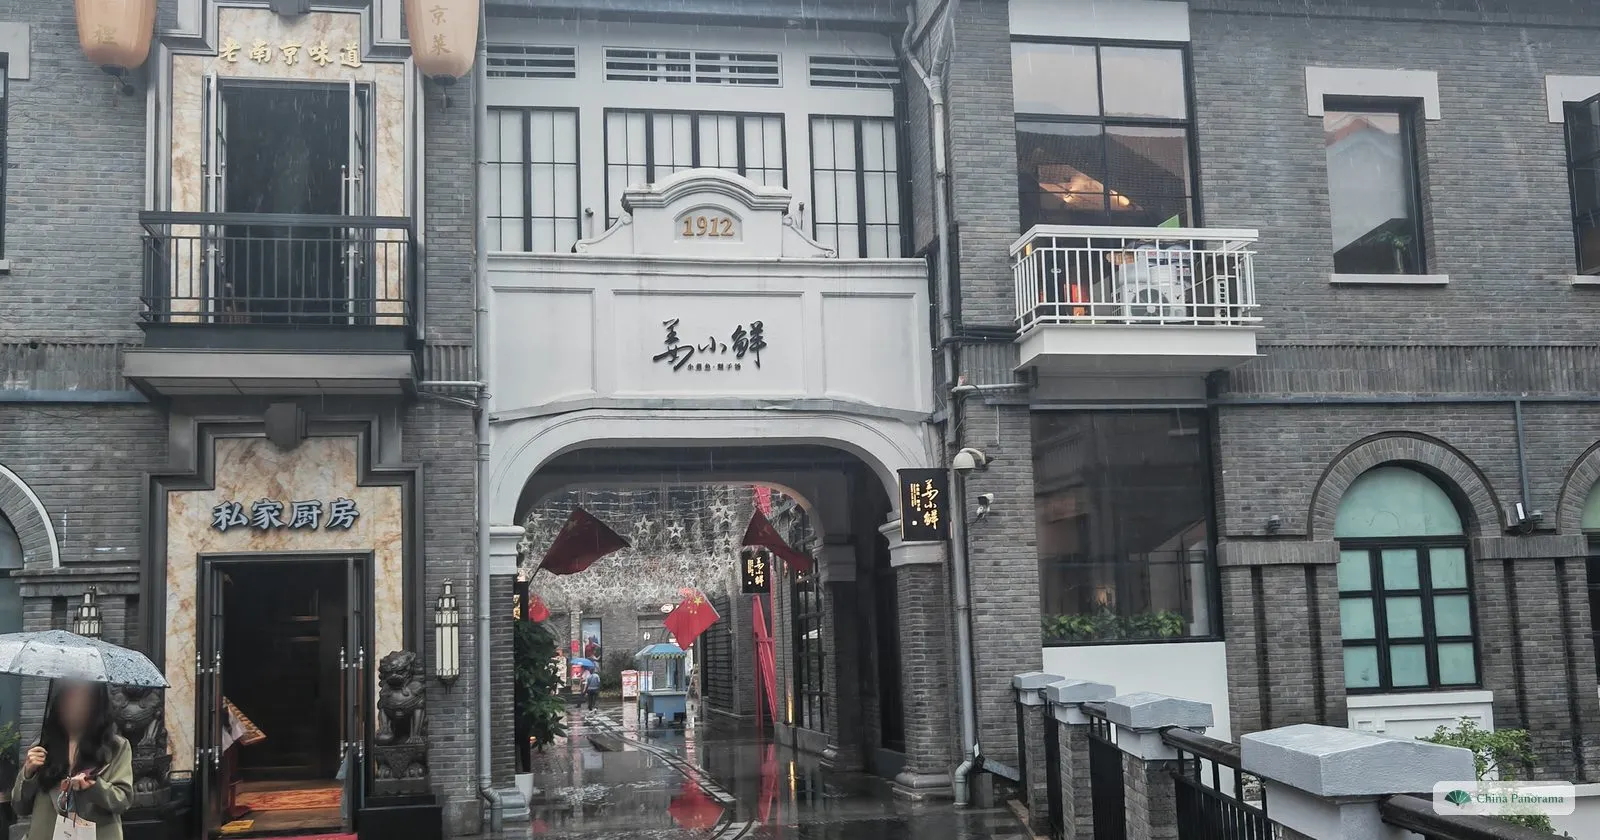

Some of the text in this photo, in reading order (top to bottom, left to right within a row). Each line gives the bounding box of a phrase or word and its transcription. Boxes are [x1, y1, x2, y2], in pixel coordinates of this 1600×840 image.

[219, 37, 362, 68] 老南京味道
[682, 216, 735, 237] 1912
[211, 498, 360, 531] 私家厨房
